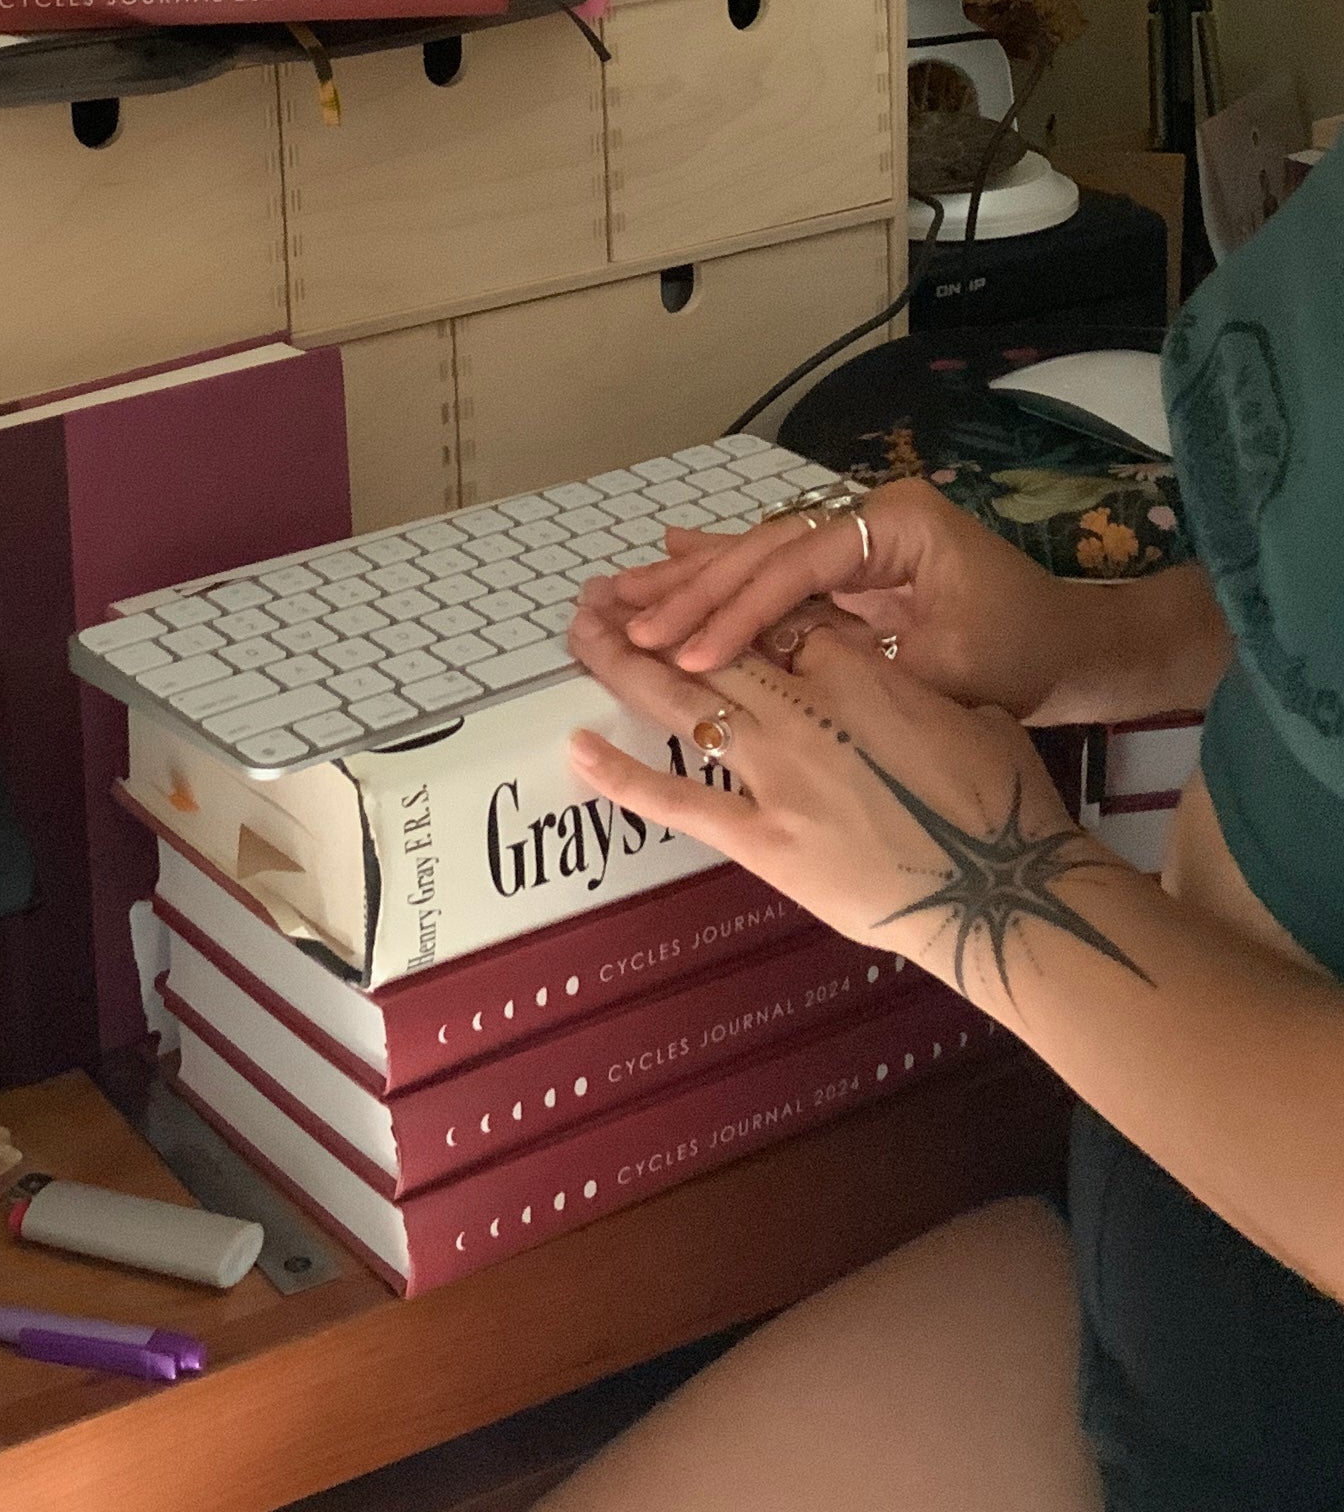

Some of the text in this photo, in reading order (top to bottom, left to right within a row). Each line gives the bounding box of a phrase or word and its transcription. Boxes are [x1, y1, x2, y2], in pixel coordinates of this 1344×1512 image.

[407, 856, 440, 905] Gray
[485, 779, 648, 899] Grays
[406, 908, 442, 971] Henry
[598, 902, 787, 984] CYCLES JOURNAL
[607, 976, 853, 1084] CYCLES JOURNAL 2024
[617, 1076, 861, 1185] CYCLES JOURNAL 2024
